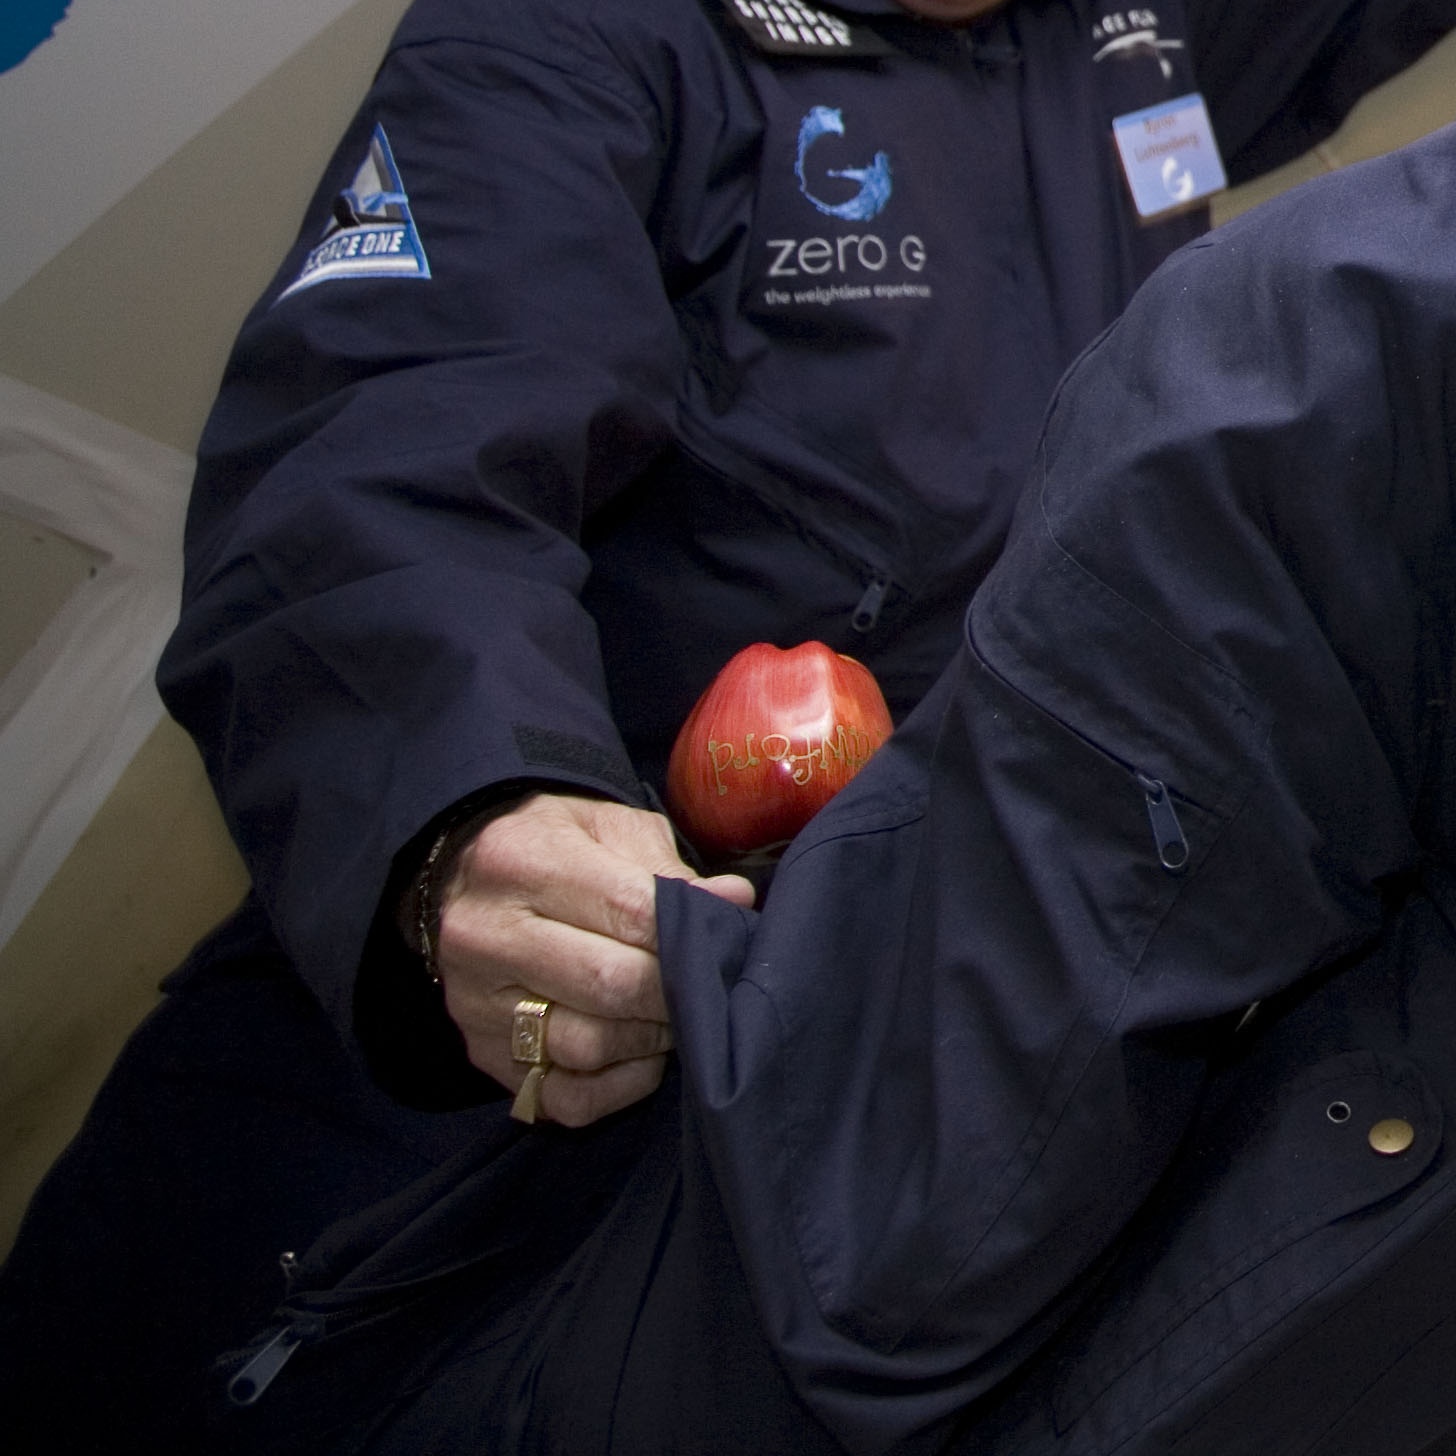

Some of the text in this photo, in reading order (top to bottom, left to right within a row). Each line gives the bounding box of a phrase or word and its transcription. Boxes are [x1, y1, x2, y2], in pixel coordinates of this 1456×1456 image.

[361, 231, 405, 256] ONE
[766, 234, 926, 276] zero G
[764, 288, 791, 305] the
[793, 284, 871, 306] weightless
[708, 725, 882, 797] awford
